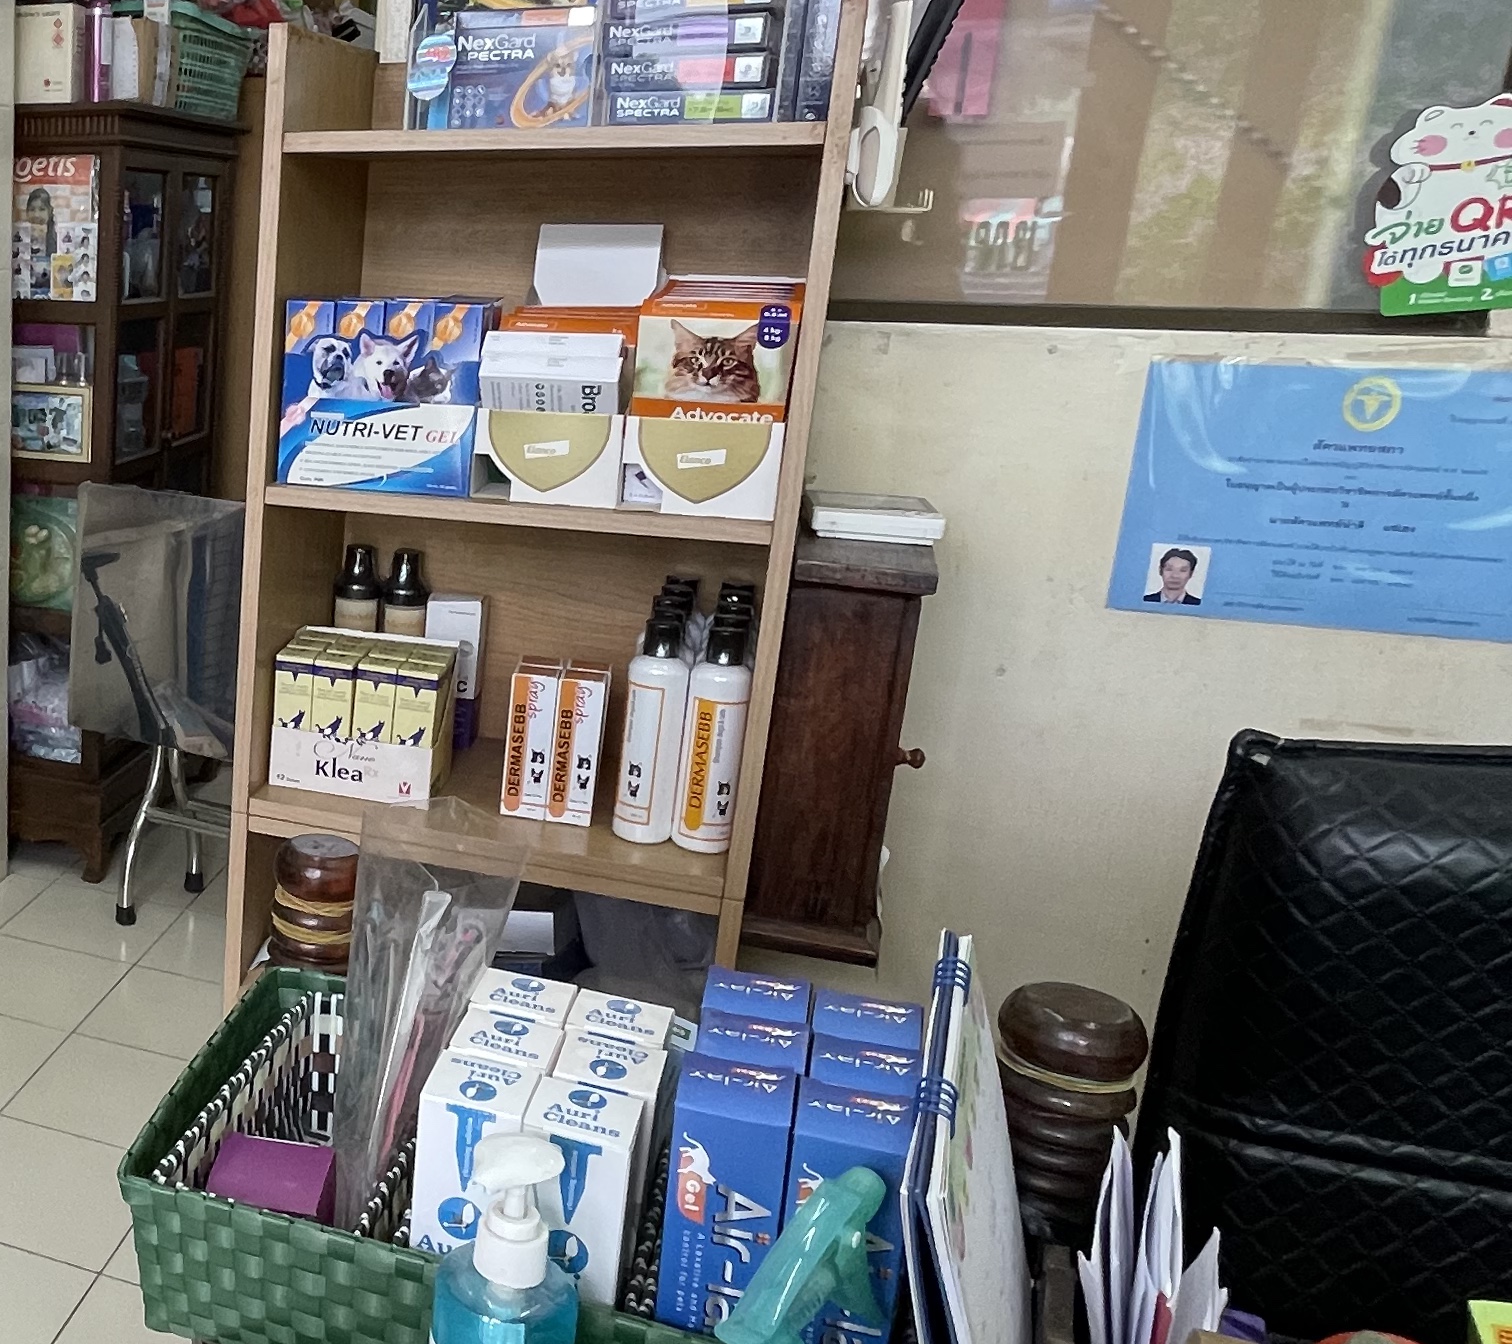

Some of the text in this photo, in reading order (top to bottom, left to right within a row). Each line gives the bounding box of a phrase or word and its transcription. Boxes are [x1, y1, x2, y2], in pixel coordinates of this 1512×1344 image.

[457, 33, 536, 52] NexGard
[467, 49, 535, 62] PECTRA
[611, 61, 674, 75] NexGard
[616, 96, 681, 110] NexGard
[616, 108, 679, 118] SPECTRA
[12, 156, 77, 183] oetis
[581, 385, 602, 413] Bro
[310, 418, 423, 442] NUTRI-VET
[528, 681, 546, 719] spray
[574, 686, 593, 724] spray
[507, 703, 527, 797] DERMASEBB
[552, 709, 574, 803] DERMASEBB
[688, 711, 714, 809] DERMASEBB
[314, 757, 363, 783] Klea
[489, 993, 556, 1014] Cleans
[490, 987, 541, 1002] Auri
[585, 1013, 655, 1036] Cleans
[588, 1008, 637, 1024] Auri
[470, 1036, 539, 1060] Cleans
[472, 1029, 522, 1046] Auri
[543, 1111, 620, 1138] Cleans
[546, 1103, 600, 1122] Auri
[683, 1179, 701, 1212] Gel
[416, 1234, 454, 1255] Au
[703, 1183, 773, 1328] Air-la
